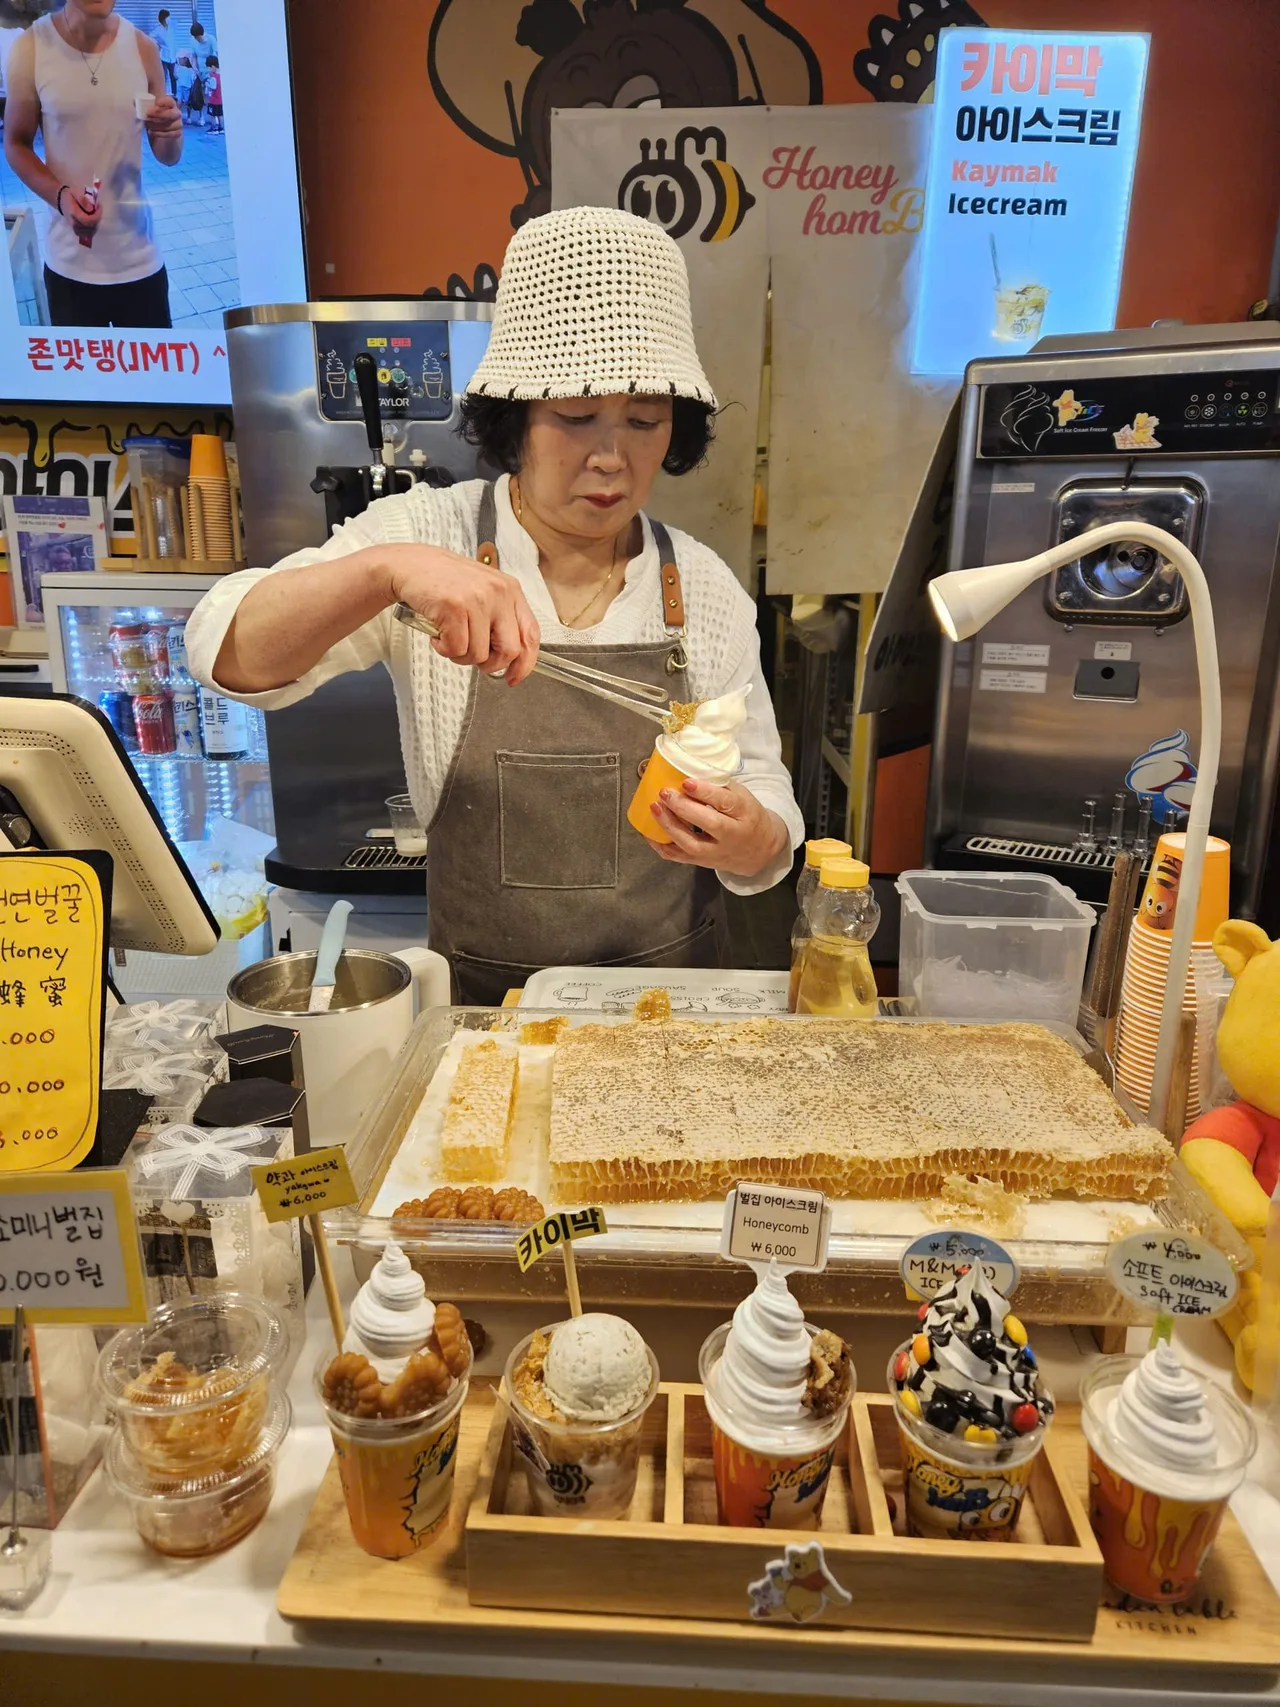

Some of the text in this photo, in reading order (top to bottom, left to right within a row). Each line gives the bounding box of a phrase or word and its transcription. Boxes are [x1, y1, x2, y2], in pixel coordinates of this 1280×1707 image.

[961, 42, 1103, 97] 카이막
[955, 105, 1121, 146] 아이스크림
[762, 145, 900, 204] Honey
[951, 160, 1060, 187] Kaymak
[948, 193, 1067, 216] Icecream
[27, 337, 200, 375] 존맛탱(JMT)
[1, 938, 69, 971] Honey
[266, 1170, 297, 1186] 약과
[740, 1192, 818, 1214] 벌집 아이스크림
[518, 1207, 600, 1267] 카이막
[743, 1216, 810, 1235] Honeycomb
[910, 1258, 956, 1275] M&M
[1122, 1258, 1164, 1285] 소프트
[1177, 1293, 1201, 1306] ICE
